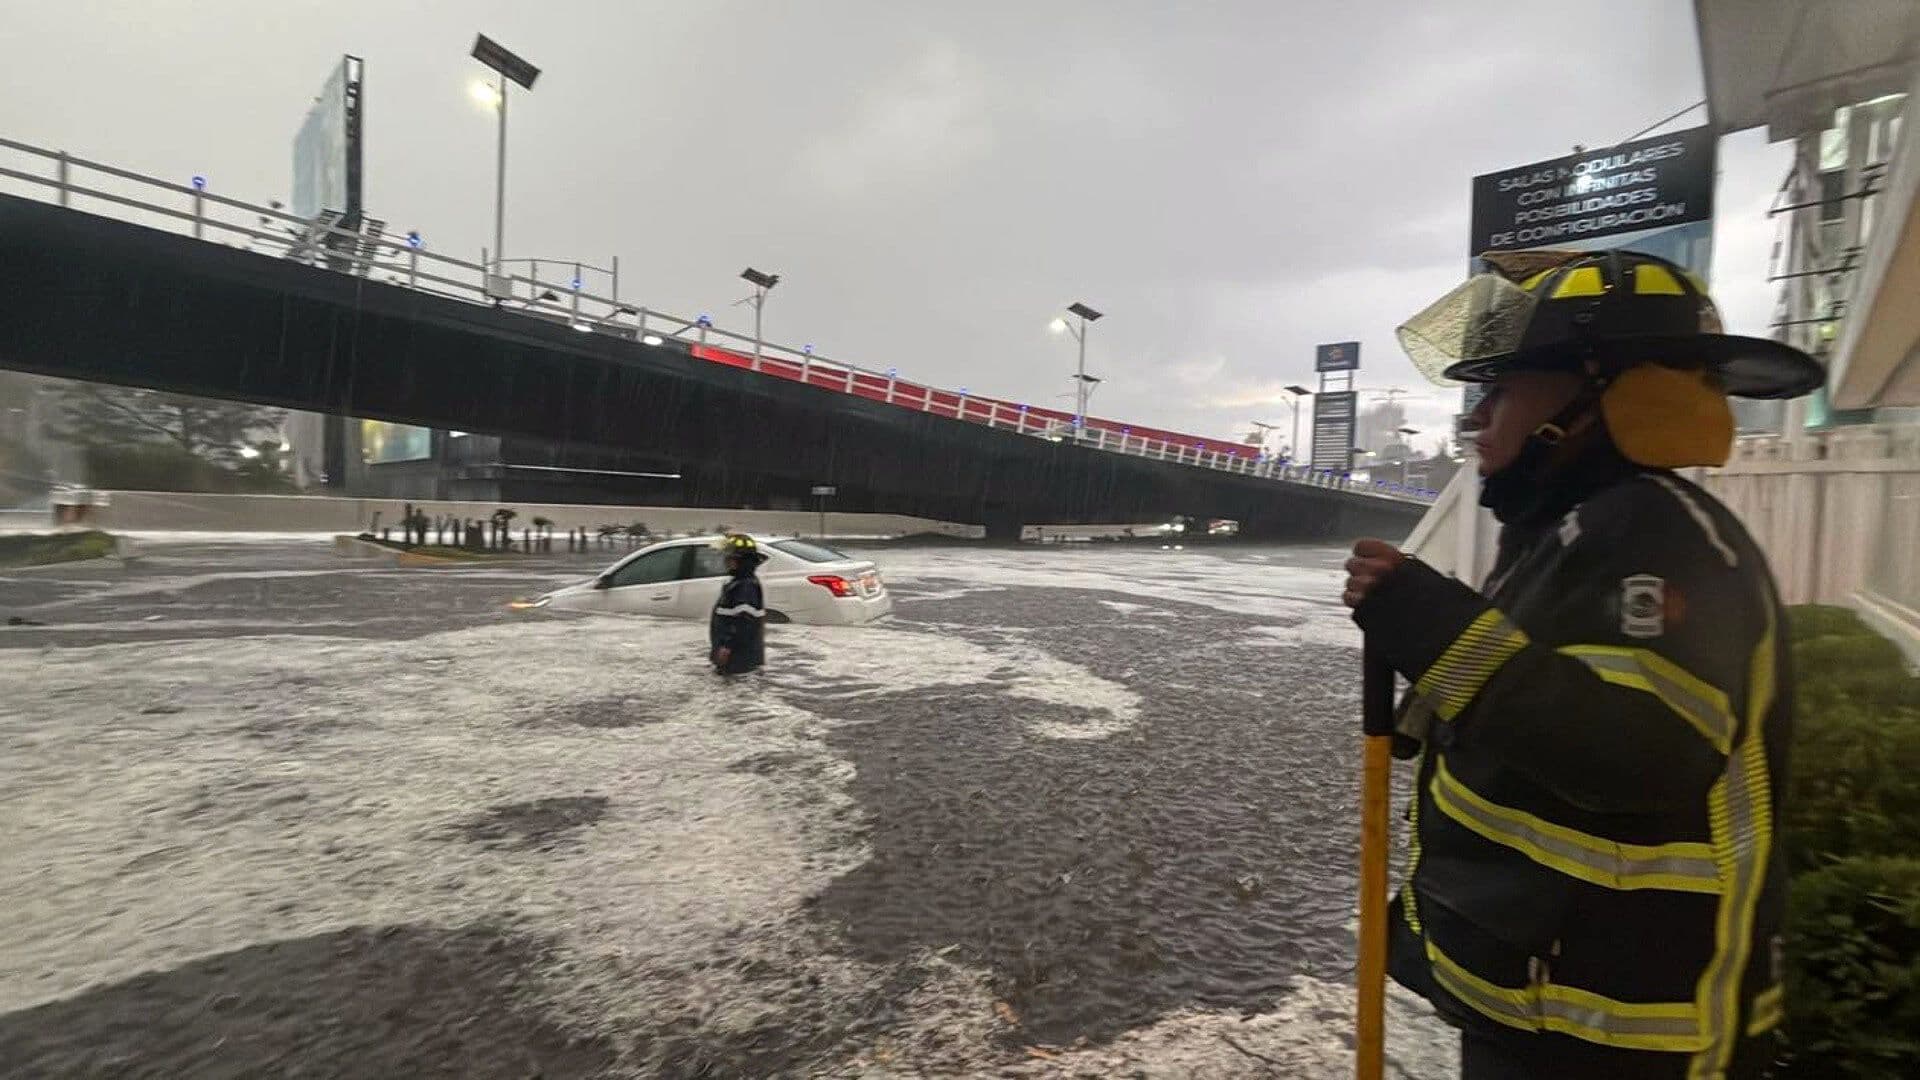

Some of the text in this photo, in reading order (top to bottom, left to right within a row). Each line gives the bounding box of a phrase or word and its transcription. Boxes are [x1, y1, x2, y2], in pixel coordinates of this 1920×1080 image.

[1499, 170, 1555, 192] SALAS
[1515, 187, 1657, 224] POSIBILIDADES
[1518, 187, 1560, 205] CON
[1491, 231, 1515, 247] DE
